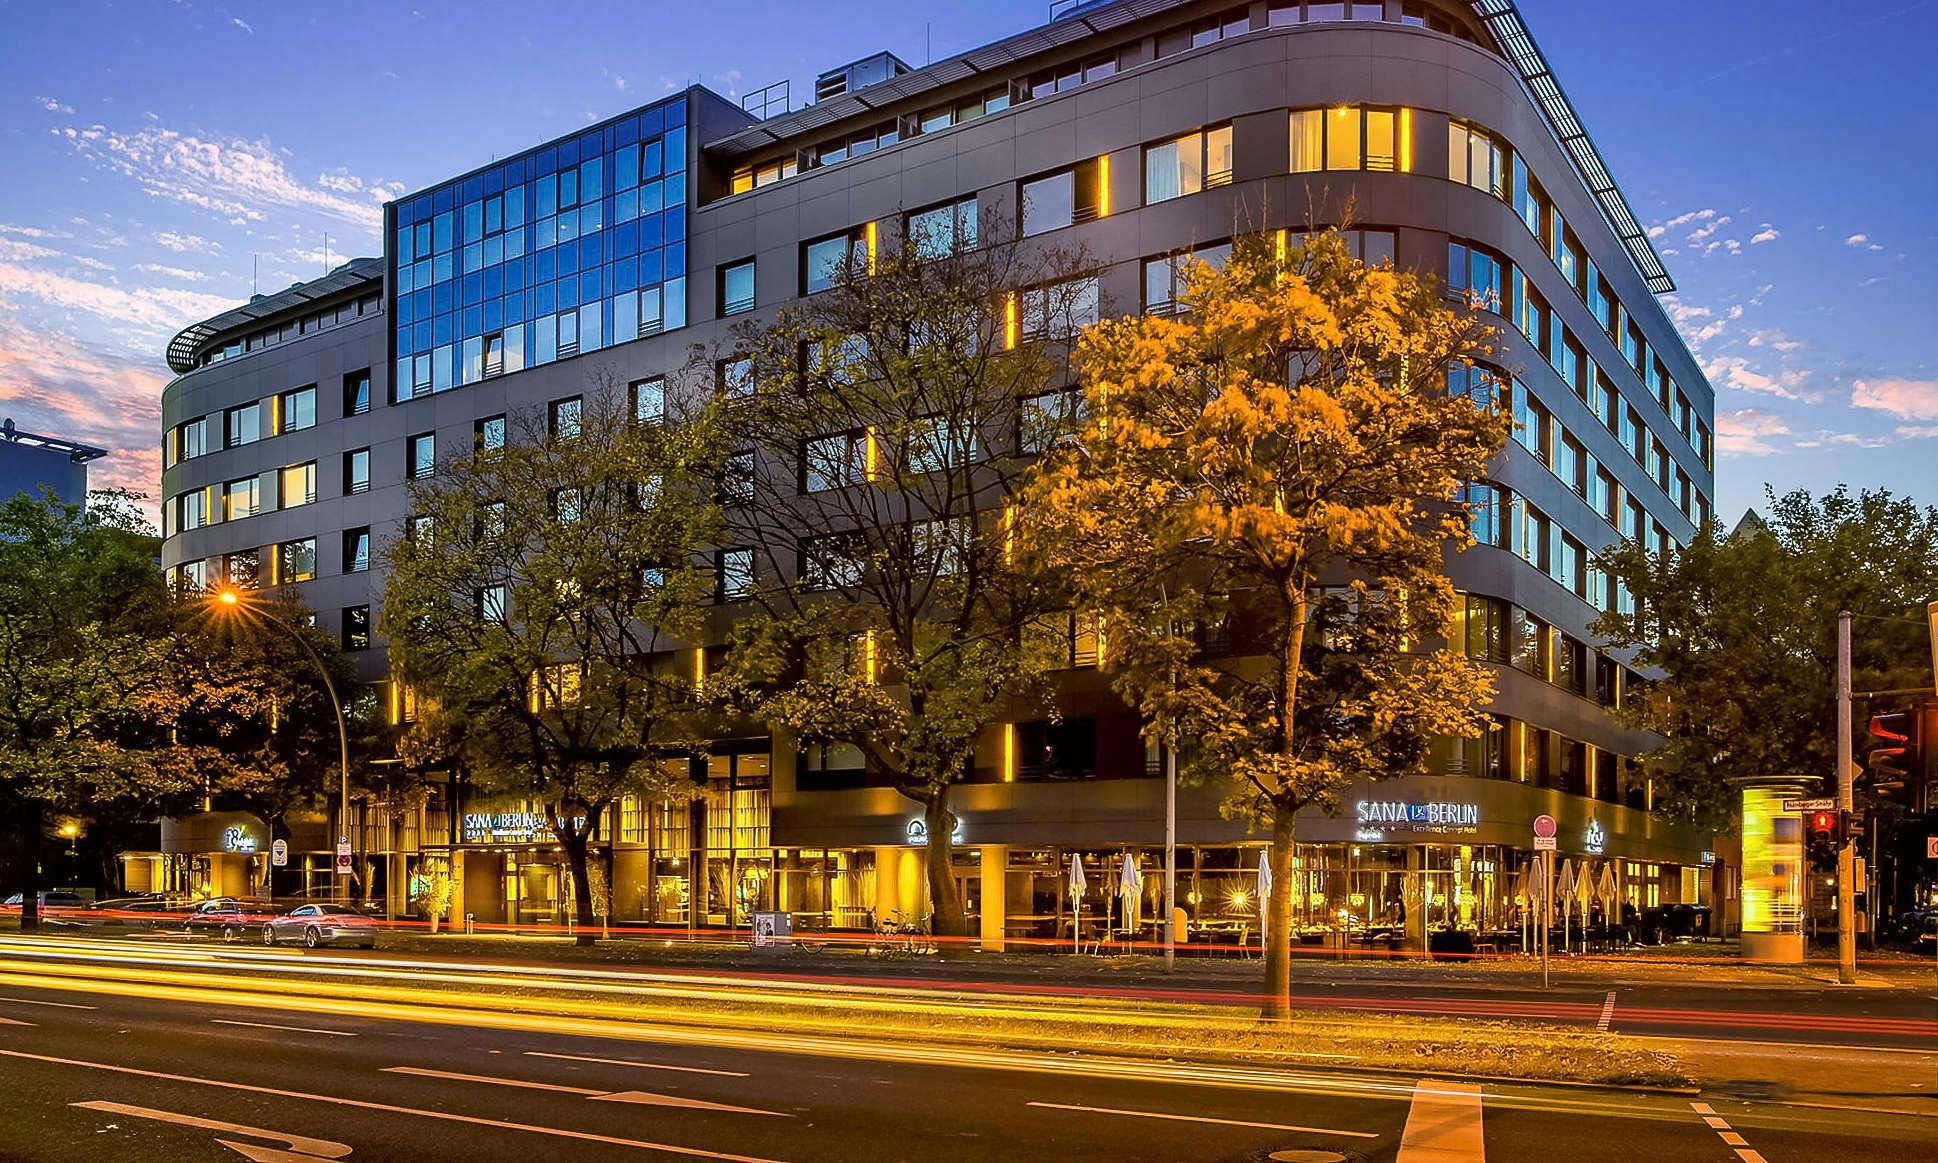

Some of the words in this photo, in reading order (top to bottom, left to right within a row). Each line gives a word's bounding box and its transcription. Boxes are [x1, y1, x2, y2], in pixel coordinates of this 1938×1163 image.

[466, 814, 492, 828] SANA
[501, 812, 533, 828] BERLIN
[1357, 801, 1409, 822] SANA
[1429, 803, 1477, 824] BERLIN
